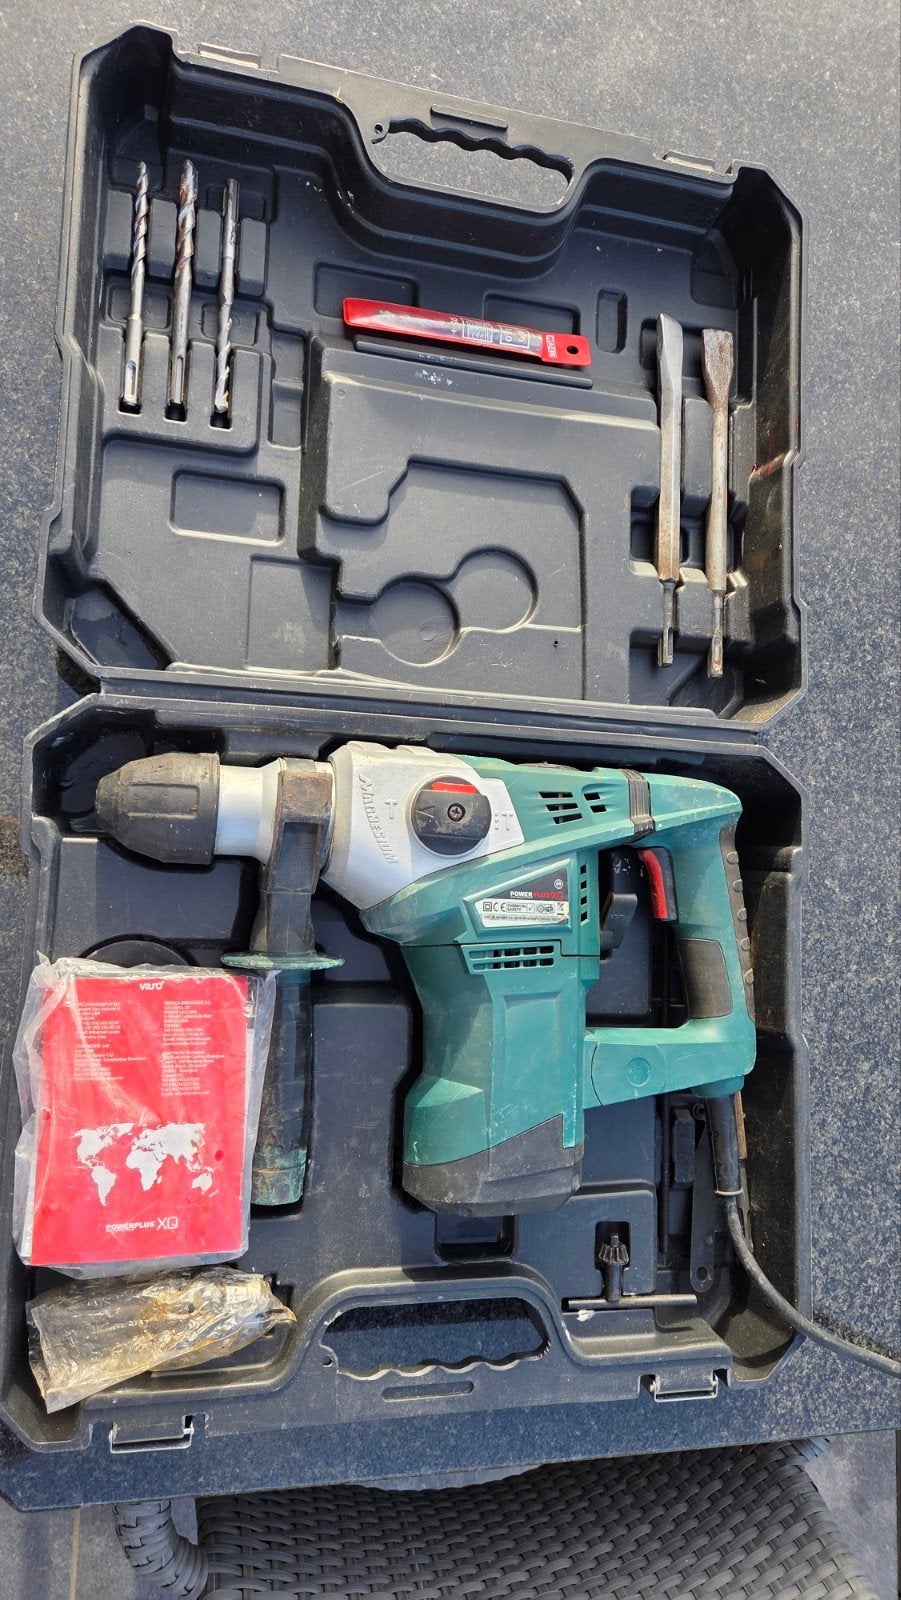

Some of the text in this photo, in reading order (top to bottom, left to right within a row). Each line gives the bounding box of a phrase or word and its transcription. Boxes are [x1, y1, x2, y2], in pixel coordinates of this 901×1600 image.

[358, 774, 399, 864] MAGNESIUM
[139, 981, 165, 991] varo
[105, 1216, 179, 1230] POWERPLUS XQ
